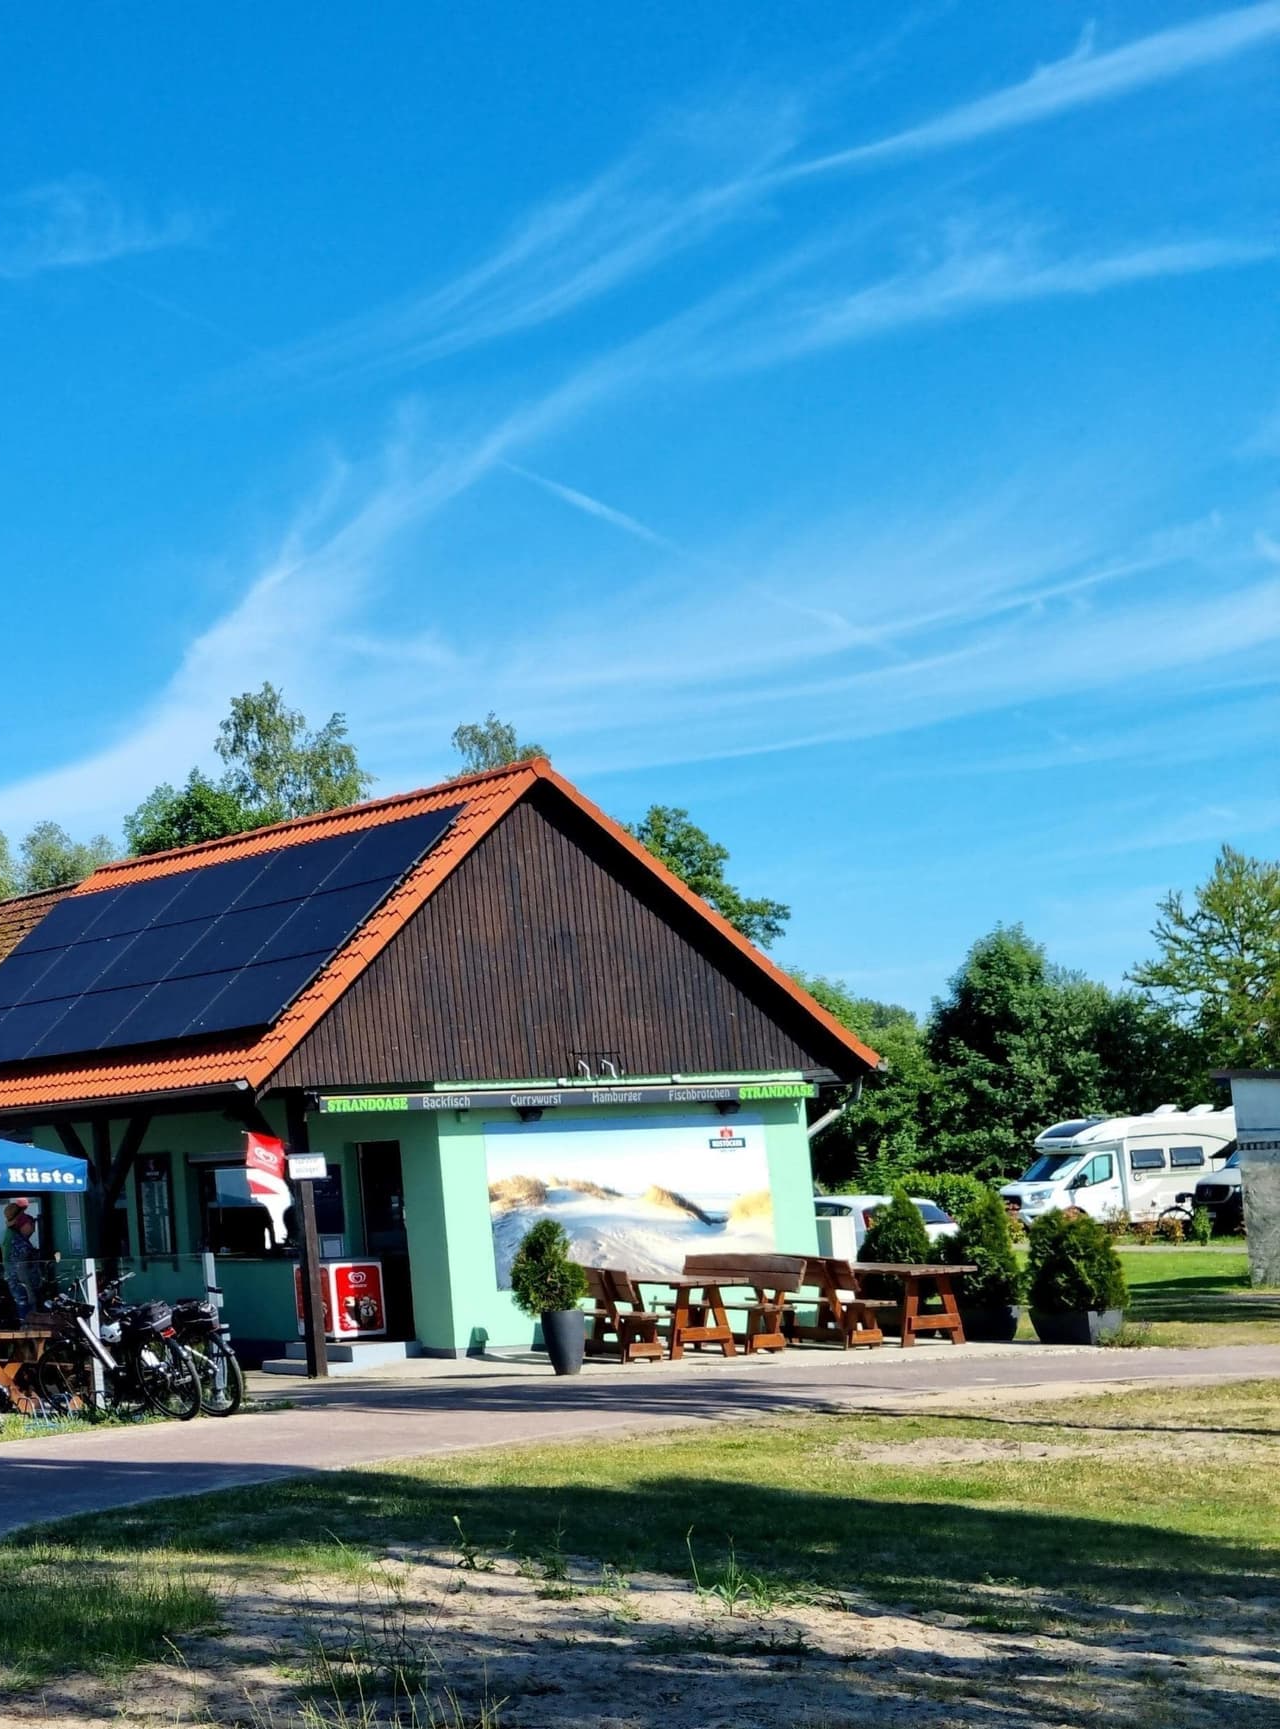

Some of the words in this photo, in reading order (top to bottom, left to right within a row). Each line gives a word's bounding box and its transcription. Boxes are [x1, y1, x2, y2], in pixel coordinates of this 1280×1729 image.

[422, 1096, 471, 1108] Backfisch
[510, 1094, 562, 1107] Currywurst
[592, 1091, 642, 1104] Hamburger
[739, 1084, 815, 1099] STRANDOASE
[327, 1097, 409, 1112] STRANDOASE
[8, 1168, 84, 1185] Küste.
